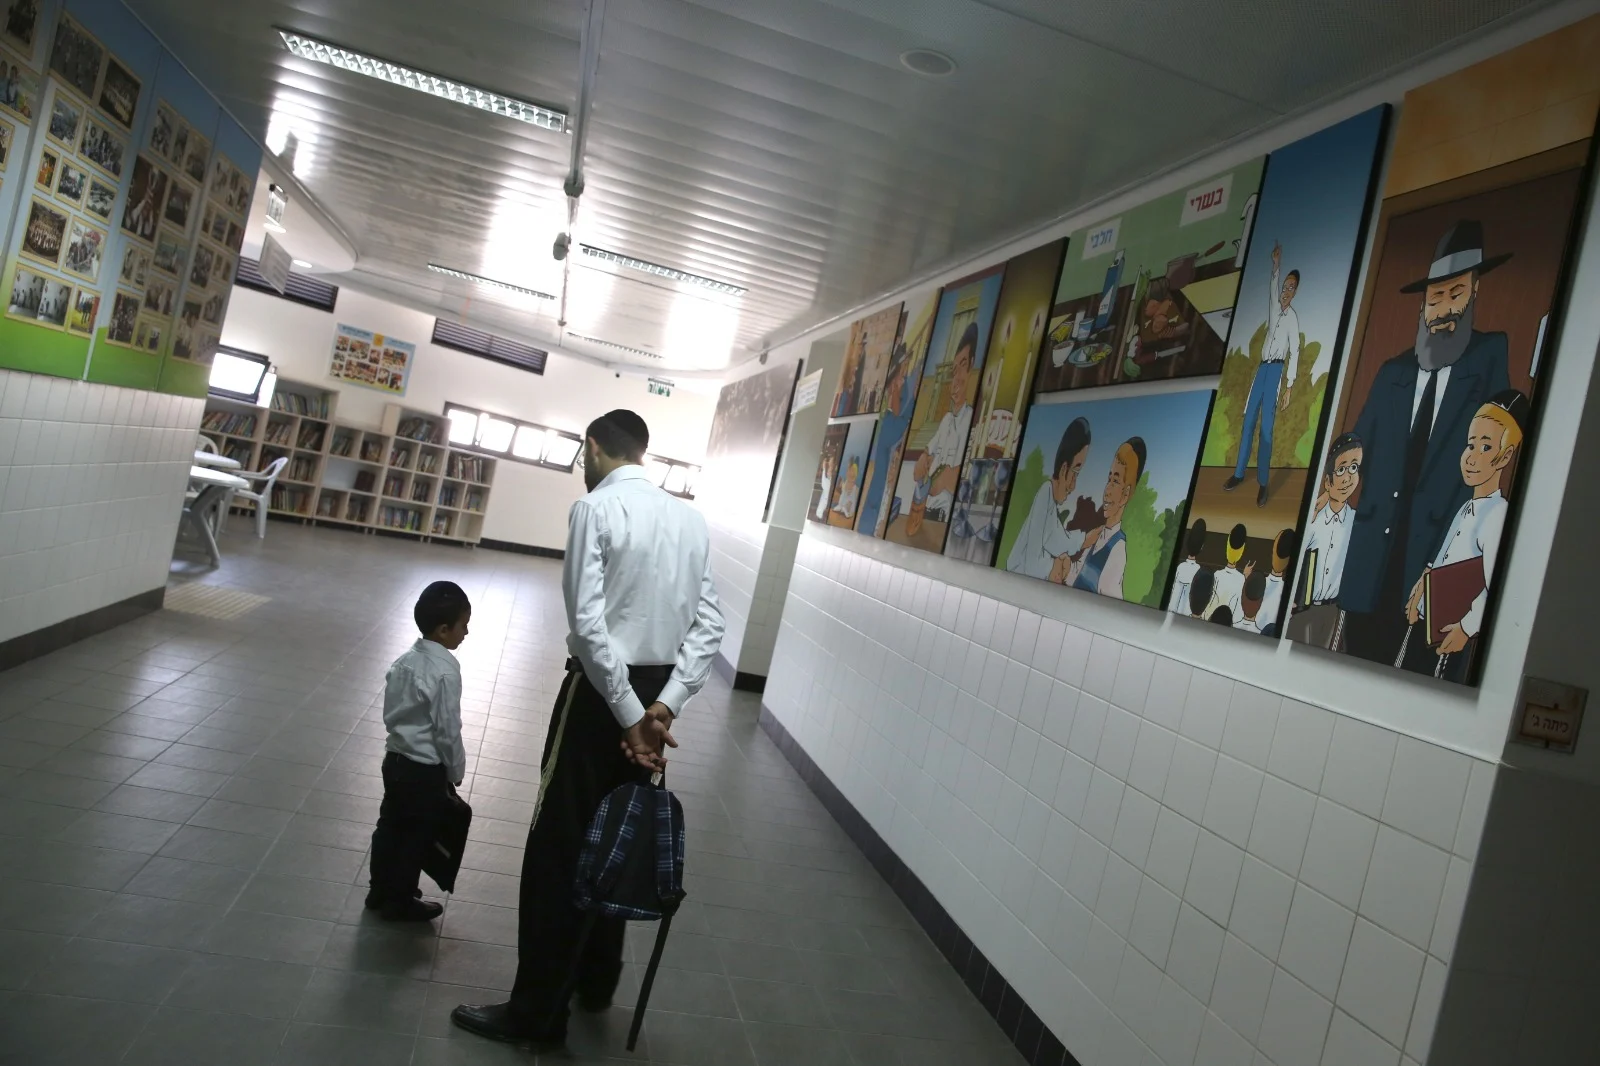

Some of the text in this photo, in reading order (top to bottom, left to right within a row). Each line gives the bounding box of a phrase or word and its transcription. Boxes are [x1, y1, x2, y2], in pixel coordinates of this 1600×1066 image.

[1190, 187, 1224, 212] בשרי
[1091, 229, 1113, 248] חלבי
[1543, 718, 1568, 733] כיתה
